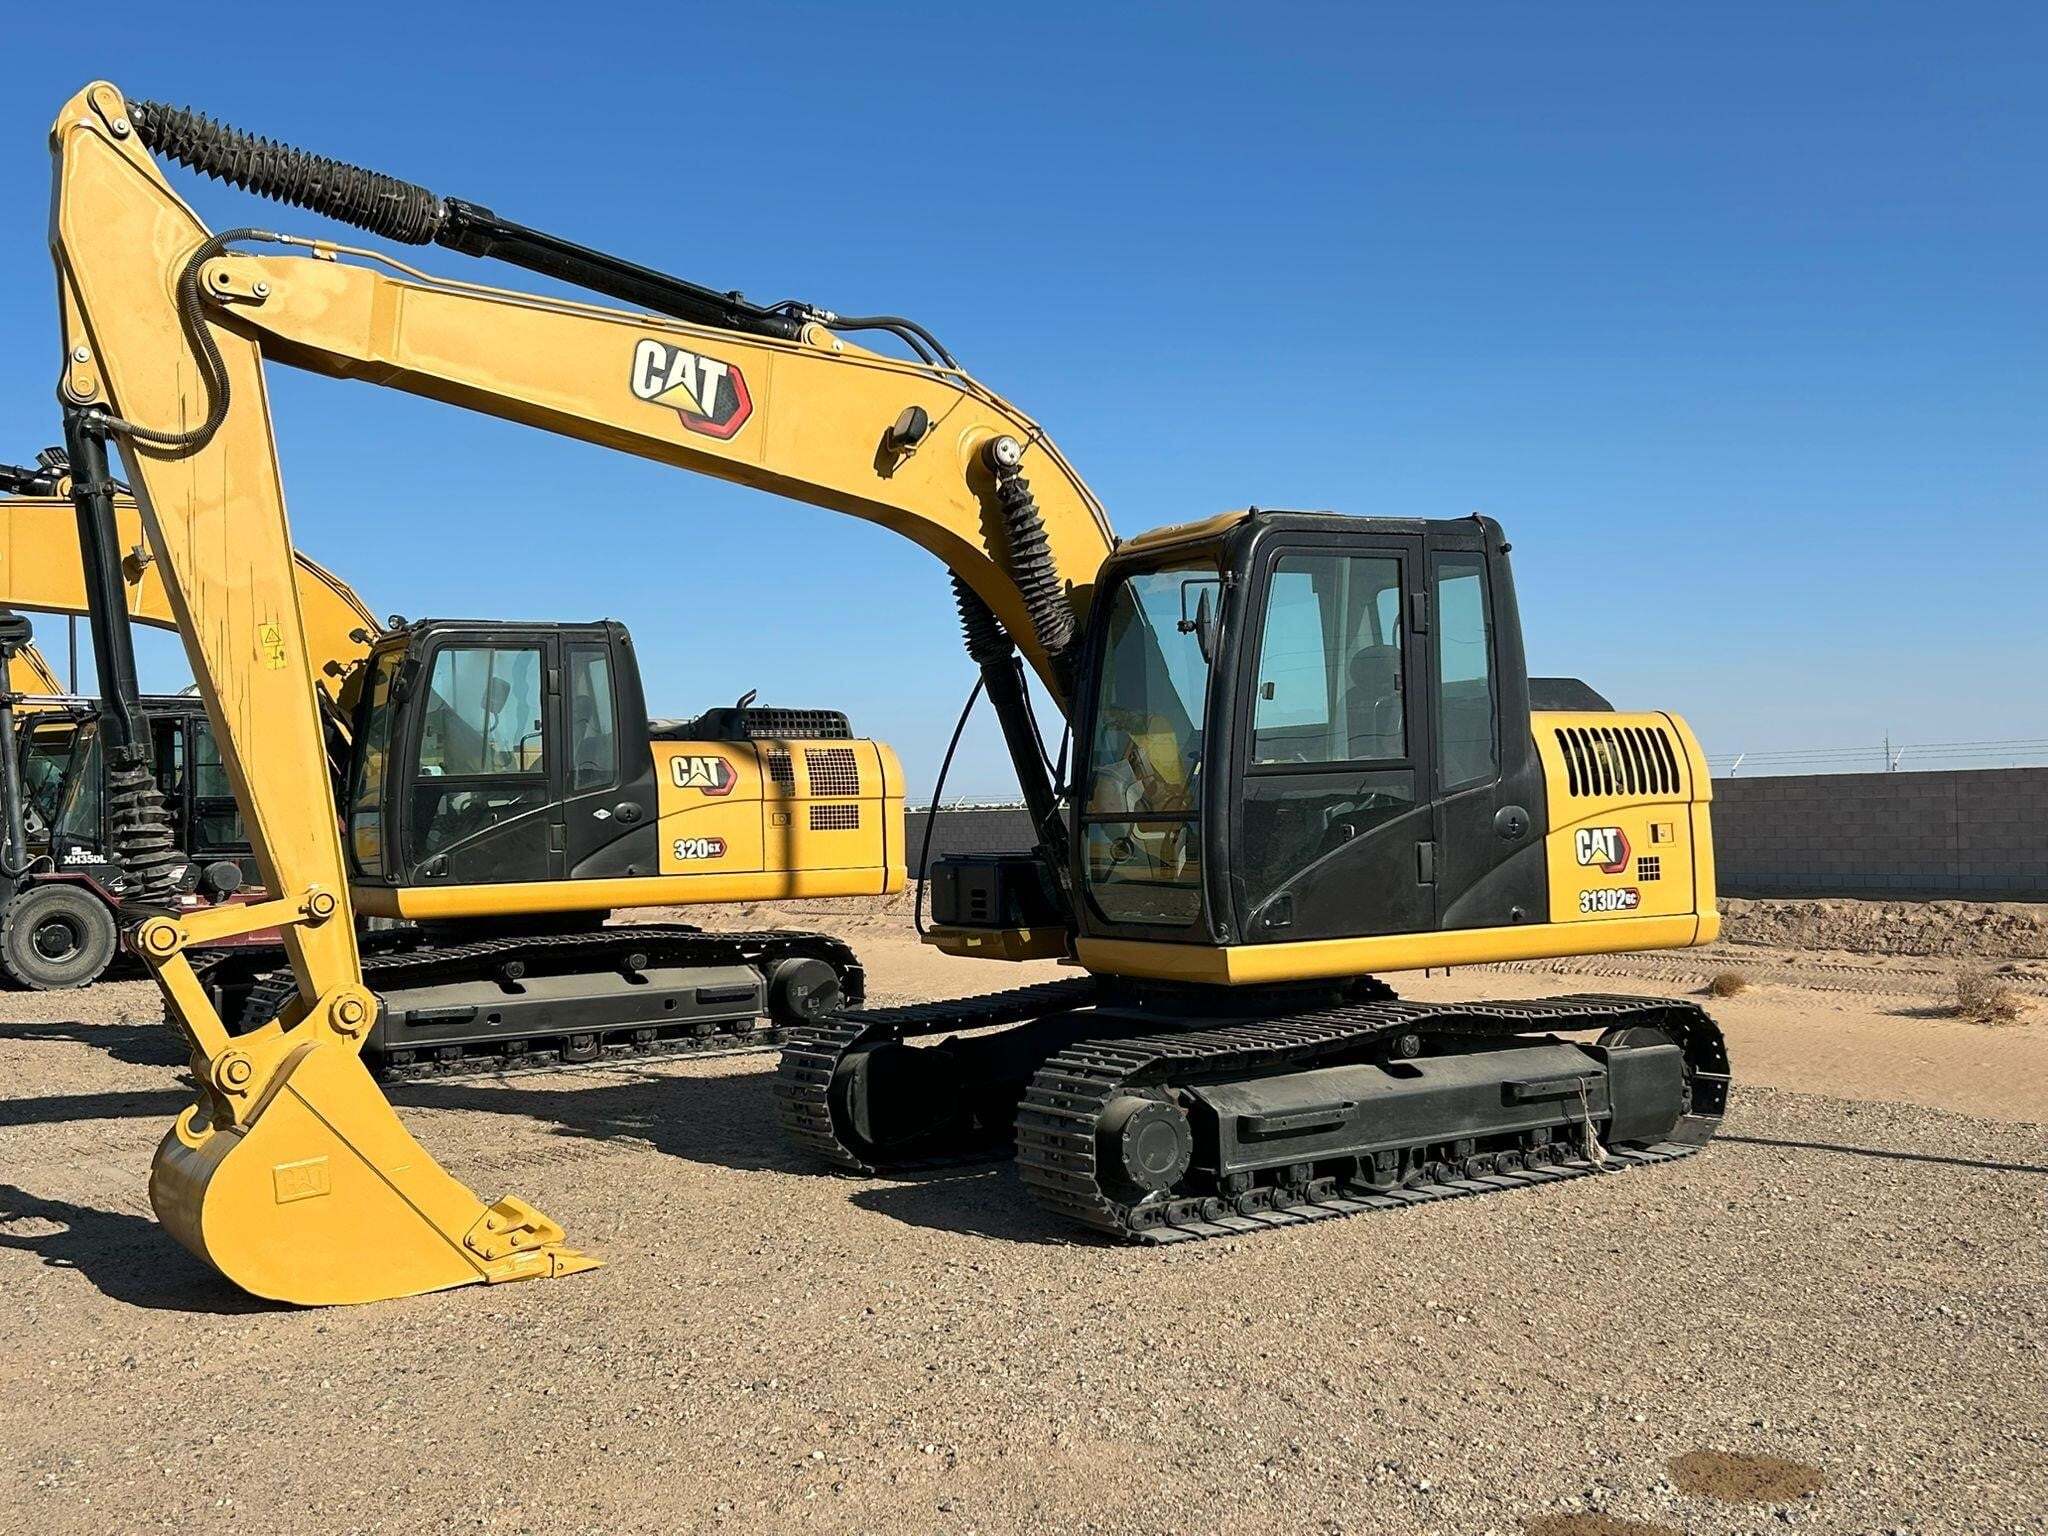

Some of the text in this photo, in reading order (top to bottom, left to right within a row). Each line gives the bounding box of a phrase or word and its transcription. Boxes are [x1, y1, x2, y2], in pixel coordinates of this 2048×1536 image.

[632, 338, 729, 418] CAT
[671, 756, 720, 787] CAT
[674, 838, 708, 859] 320
[1576, 828, 1617, 865] CAT
[1580, 888, 1626, 912] 313D2
